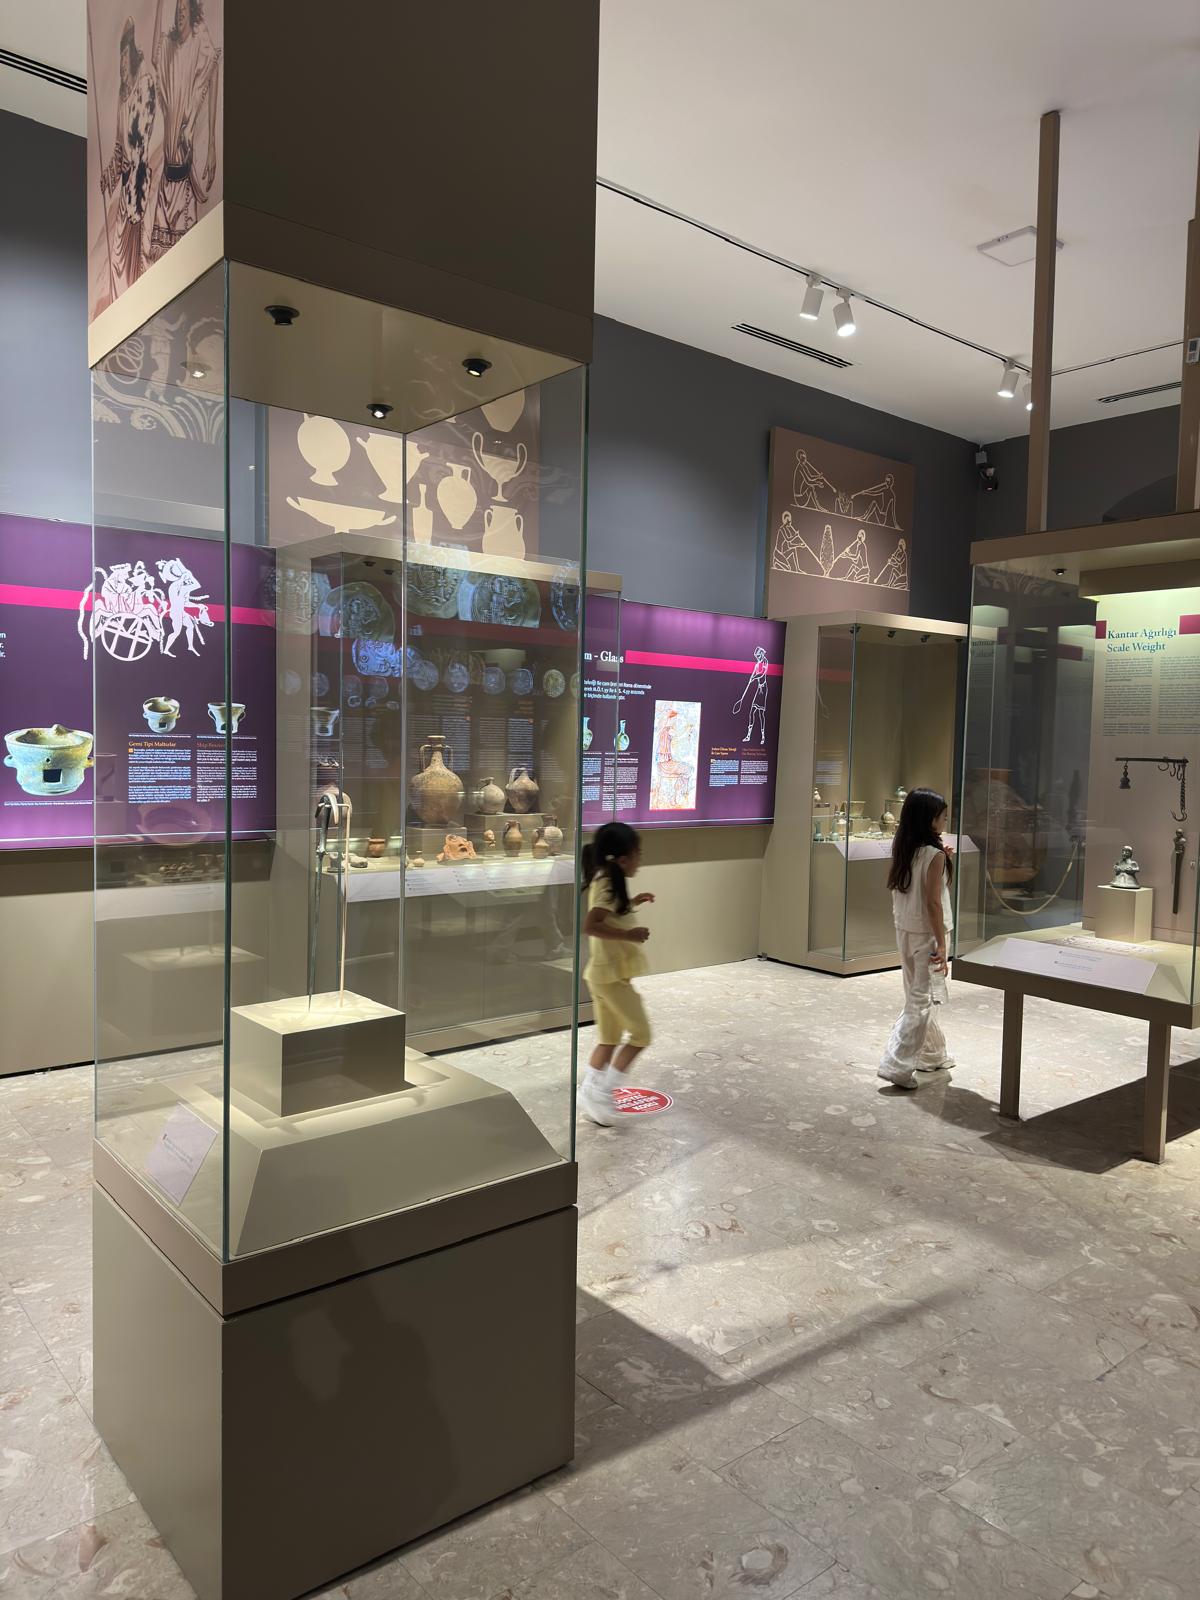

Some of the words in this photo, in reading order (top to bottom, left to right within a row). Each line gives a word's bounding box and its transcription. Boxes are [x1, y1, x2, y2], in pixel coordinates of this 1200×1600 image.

[1108, 630, 1138, 639] Kantar
[1107, 643, 1130, 652] Scale
[1132, 642, 1165, 653] Weight
